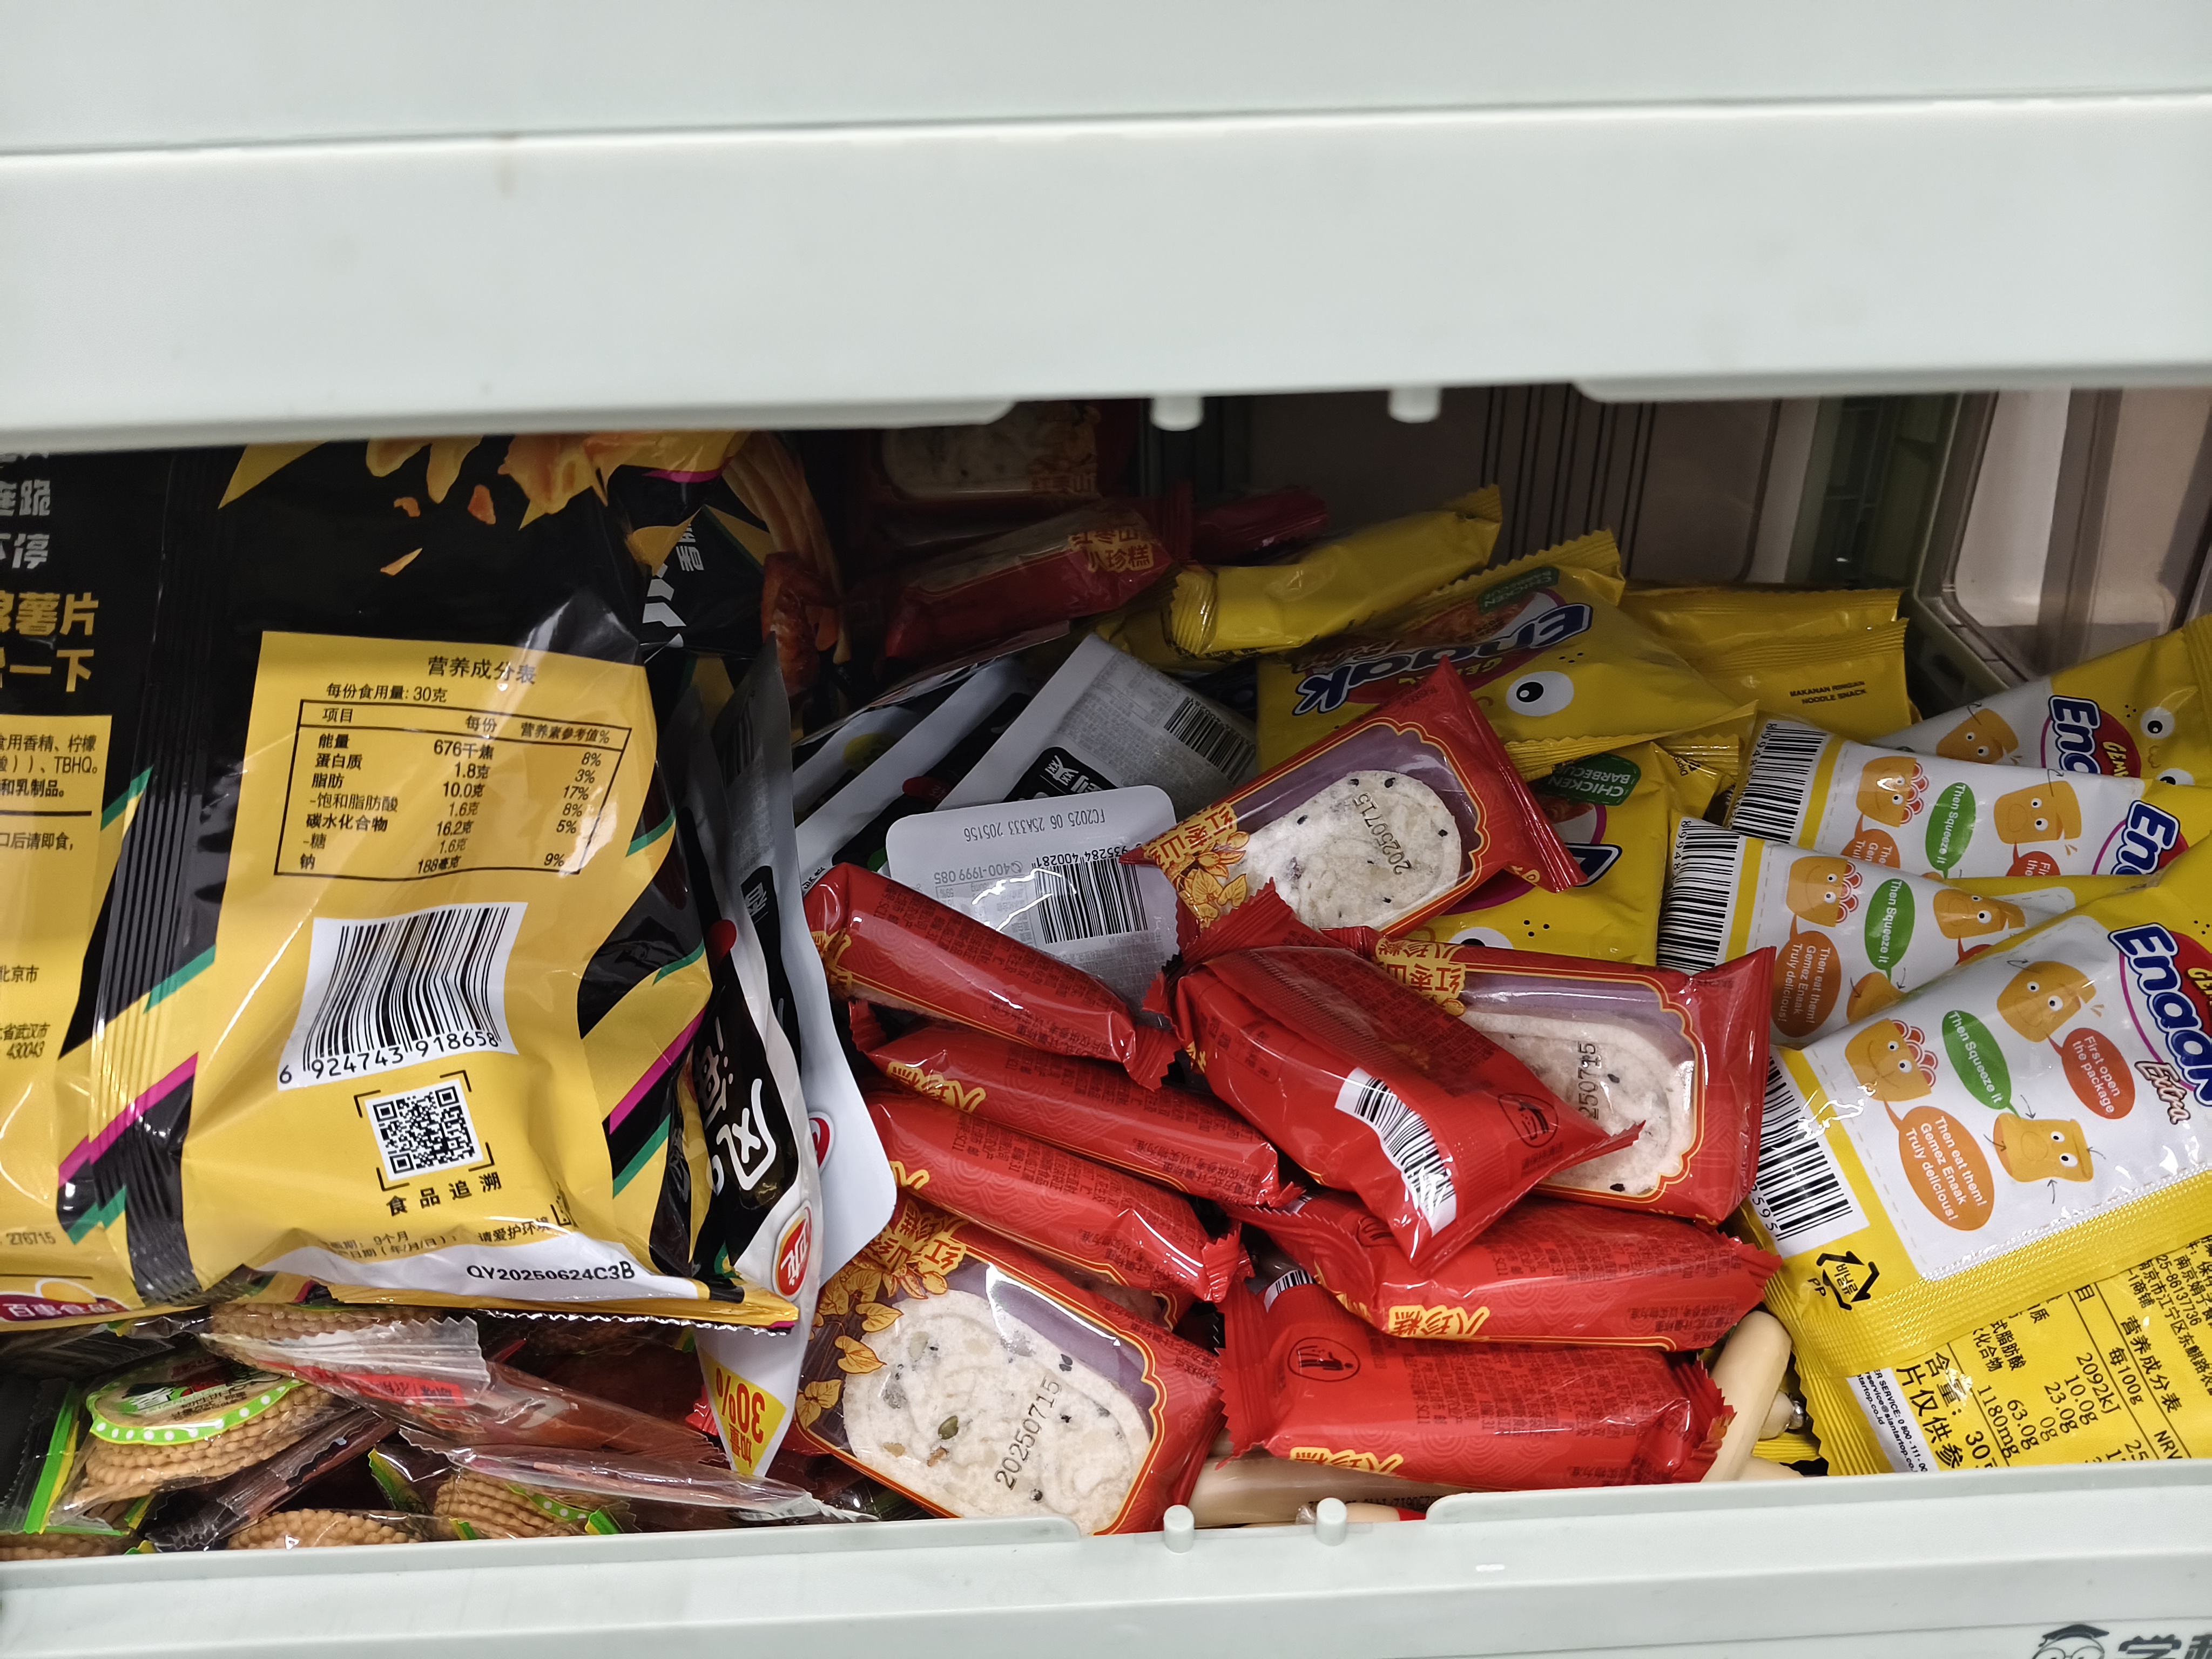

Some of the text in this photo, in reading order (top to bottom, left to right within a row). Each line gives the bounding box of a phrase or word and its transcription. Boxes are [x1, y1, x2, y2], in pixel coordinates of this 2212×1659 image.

[1088, 544, 1150, 570] 八珍糕
[0, 648, 95, 692] 一下
[428, 655, 536, 685] 营养成分表
[1292, 604, 1593, 716] Enaak
[413, 686, 448, 703] 30克
[322, 707, 354, 724] 项目
[466, 714, 497, 733] 每份
[314, 752, 595, 784] 蛋白质 1.8克 3%
[318, 733, 601, 767] 能量 676千焦 8%
[311, 773, 589, 800] 脂肪 10.0克 17%
[1547, 774, 1624, 798] CHICKEN
[1951, 785, 1966, 810] Then
[306, 813, 577, 837] 碳水化合物 16.2克 5%
[448, 801, 480, 818] 1.6克
[561, 803, 583, 818] 8%
[1050, 814, 1063, 830] 06
[1067, 809, 1105, 828] FC2025
[439, 838, 469, 855] 1.6克
[1352, 792, 1412, 876] 20250715
[1939, 811, 1959, 855] Squeeze
[300, 853, 565, 874] 钠 188毫克 9%
[1036, 853, 1079, 868] 400281
[1888, 880, 1903, 906] Then
[1881, 907, 1898, 954] Squeeze
[1780, 943, 1803, 1022] Truly delicious!
[1792, 946, 1817, 1015] Gemez Enaak
[1805, 947, 1831, 1024] Then eat them!
[279, 1031, 500, 1084] 6 924743 918658
[1948, 1011, 2004, 1103] Then Squeeze It
[2072, 1041, 2115, 1114] the package
[2084, 1035, 2121, 1097] First open
[2135, 1061, 2191, 1124] Extra
[1906, 1128, 1959, 1221] Truly delicious!
[1920, 1123, 1967, 1205] Gemez Enaak
[1934, 1116, 1987, 1208] Then eat them!
[386, 1171, 502, 1217] 食品追溯
[467, 1260, 636, 1280] QY20250624C3B
[1835, 1263, 1859, 1296] 비닐류
[2156, 1254, 2202, 1326] 25-86137736
[1393, 1310, 1487, 1337] 八珍糕
[2076, 1352, 2121, 1415] 2092kJ
[2108, 1347, 2144, 1406] 每100g
[2120, 1315, 2183, 1413] 营养成分表
[716, 1367, 765, 1444] 30%
[1977, 1385, 2020, 1459] 1180mg
[2045, 1381, 2079, 1434] 23.0g
[2064, 1374, 2098, 1426] 10.0g
[994, 1374, 1062, 1491] 20250715
[2007, 1399, 2040, 1451] 63.0g
[2039, 1416, 2059, 1442] 0g
